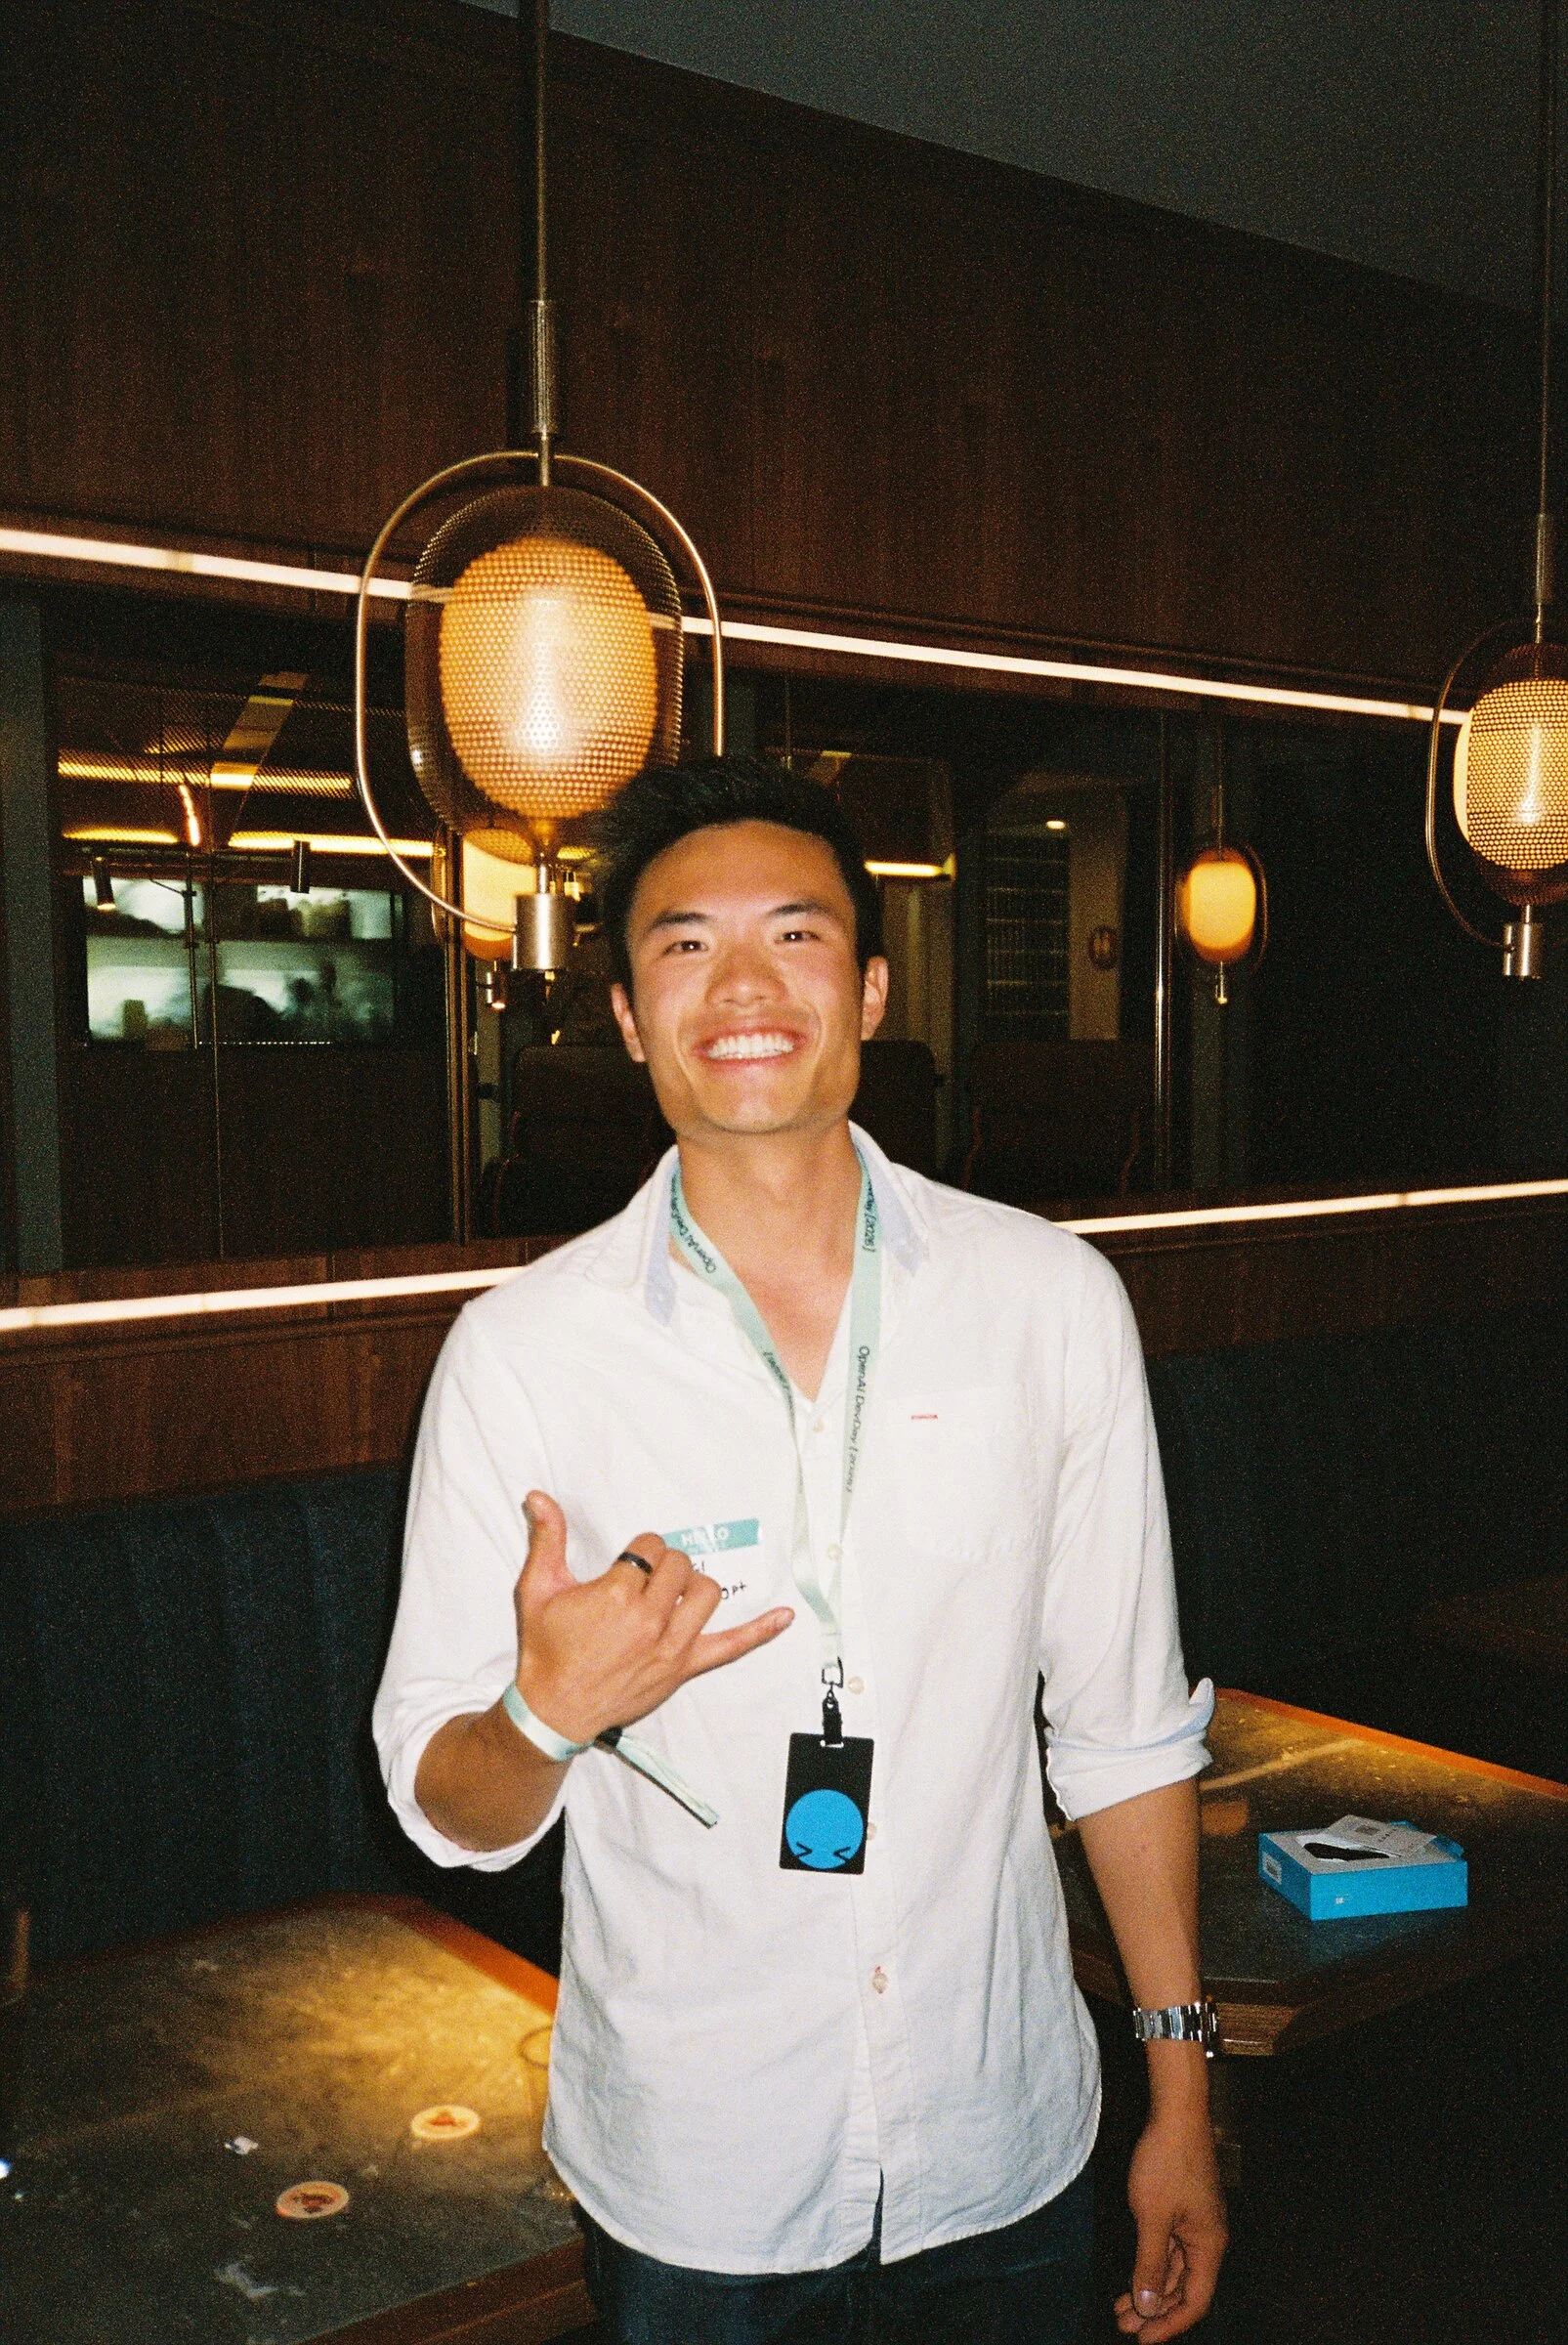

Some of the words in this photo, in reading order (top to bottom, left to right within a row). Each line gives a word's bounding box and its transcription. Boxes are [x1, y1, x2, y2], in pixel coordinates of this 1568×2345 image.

[687, 1234, 716, 1273] OpenAI
[857, 1344, 870, 1392] OpenAI
[850, 1395, 865, 1445] DevDay
